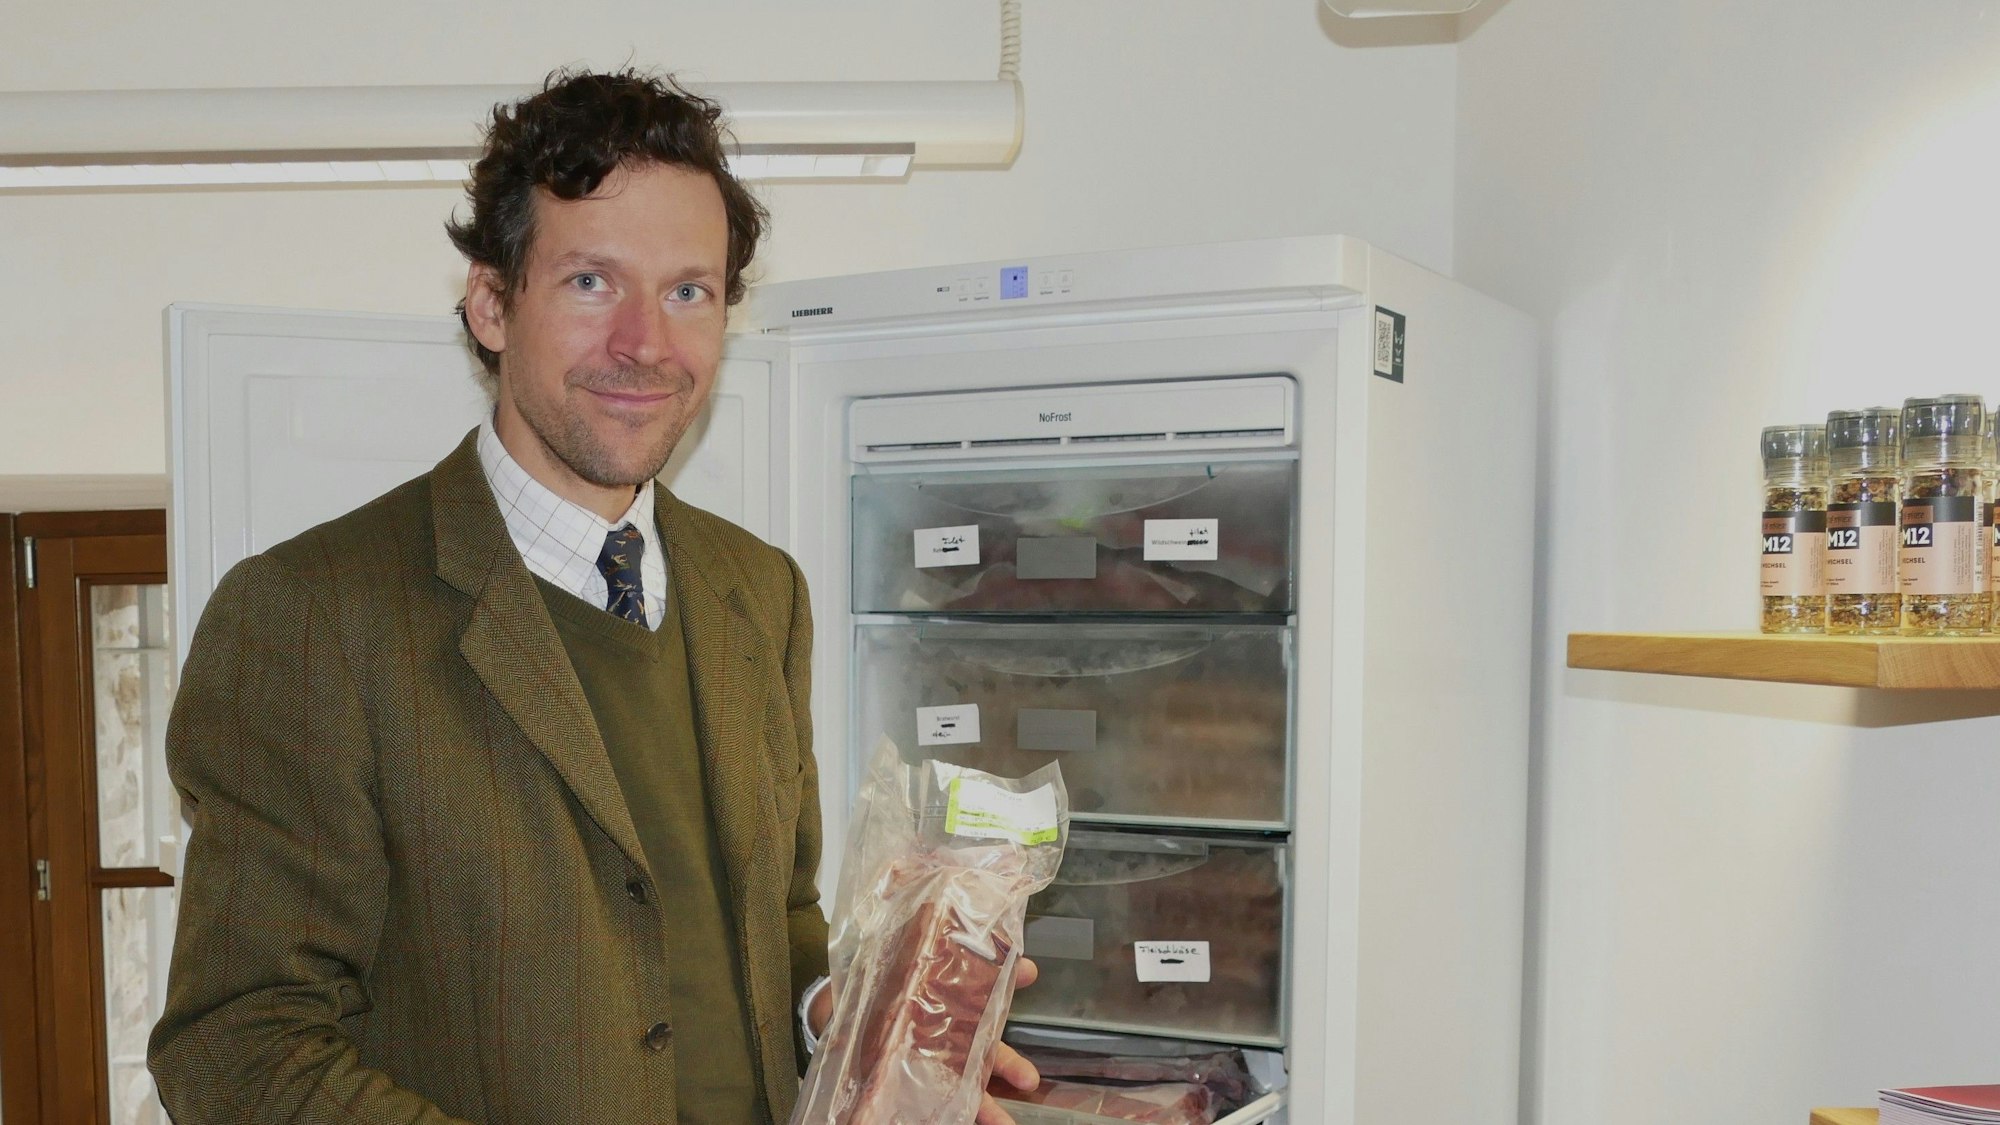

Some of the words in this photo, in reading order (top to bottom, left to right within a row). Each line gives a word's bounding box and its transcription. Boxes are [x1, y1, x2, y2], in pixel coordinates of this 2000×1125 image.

[792, 307, 833, 318] LIEBHERR
[1039, 412, 1072, 423] NoFrost
[1763, 536, 1792, 552] M12
[1828, 530, 1857, 548] M12
